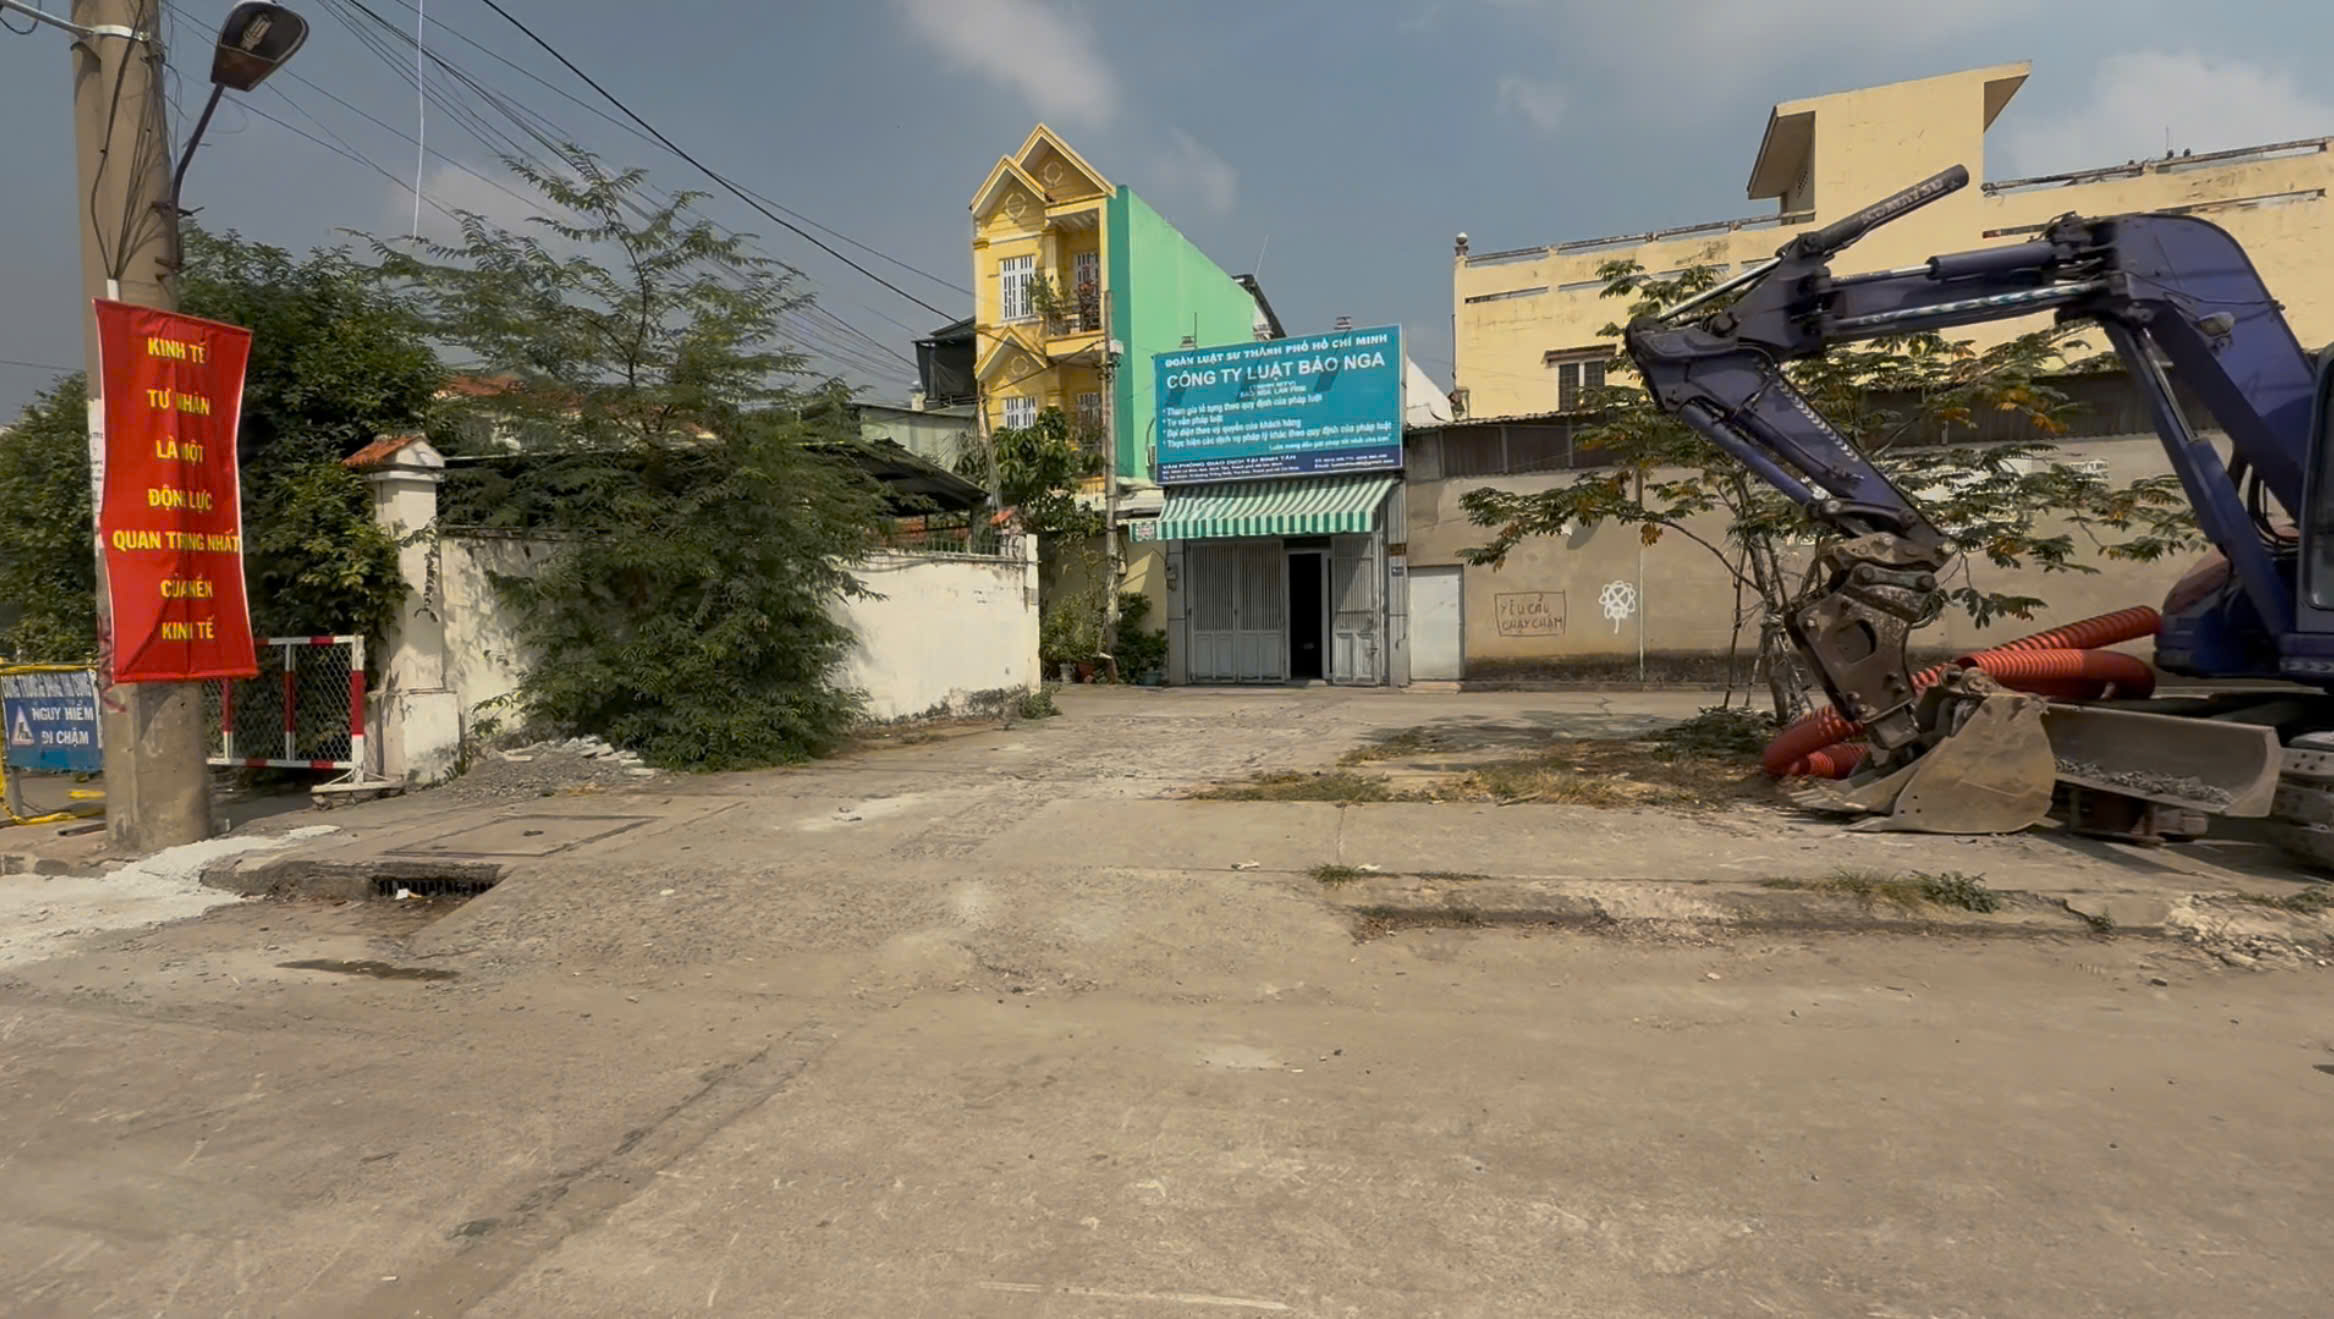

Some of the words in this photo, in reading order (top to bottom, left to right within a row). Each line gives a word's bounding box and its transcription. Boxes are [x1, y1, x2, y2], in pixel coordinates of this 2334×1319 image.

[147, 337, 186, 360] KINH
[188, 341, 207, 364] TẾ
[1197, 353, 1225, 365] LUẬT
[1225, 351, 1241, 361] SƯ
[1243, 346, 1282, 359] THÀNH
[1286, 339, 1309, 354] PHỐ
[1312, 337, 1328, 350] HỒ
[1332, 336, 1352, 348] CHÍ
[1356, 334, 1388, 346] MINH
[1167, 370, 1216, 389] CÔNG
[1220, 367, 1242, 384] TY
[1247, 361, 1294, 381] LUẬT
[1298, 355, 1338, 375] BẢO
[1344, 352, 1385, 371] NGA
[147, 388, 171, 409] TƯ
[156, 434, 178, 460] LÀ
[148, 483, 186, 511] ĐỘN
[189, 489, 213, 515] LỰC
[112, 529, 162, 552] QUAN
[165, 531, 204, 551] TNG
[207, 528, 240, 552] NHẤT
[197, 614, 215, 640] TẾ
[31, 707, 61, 721] NGUY
[64, 700, 94, 721] HIỂM
[41, 730, 54, 745] ĐI
[56, 727, 89, 748] CHẬM
